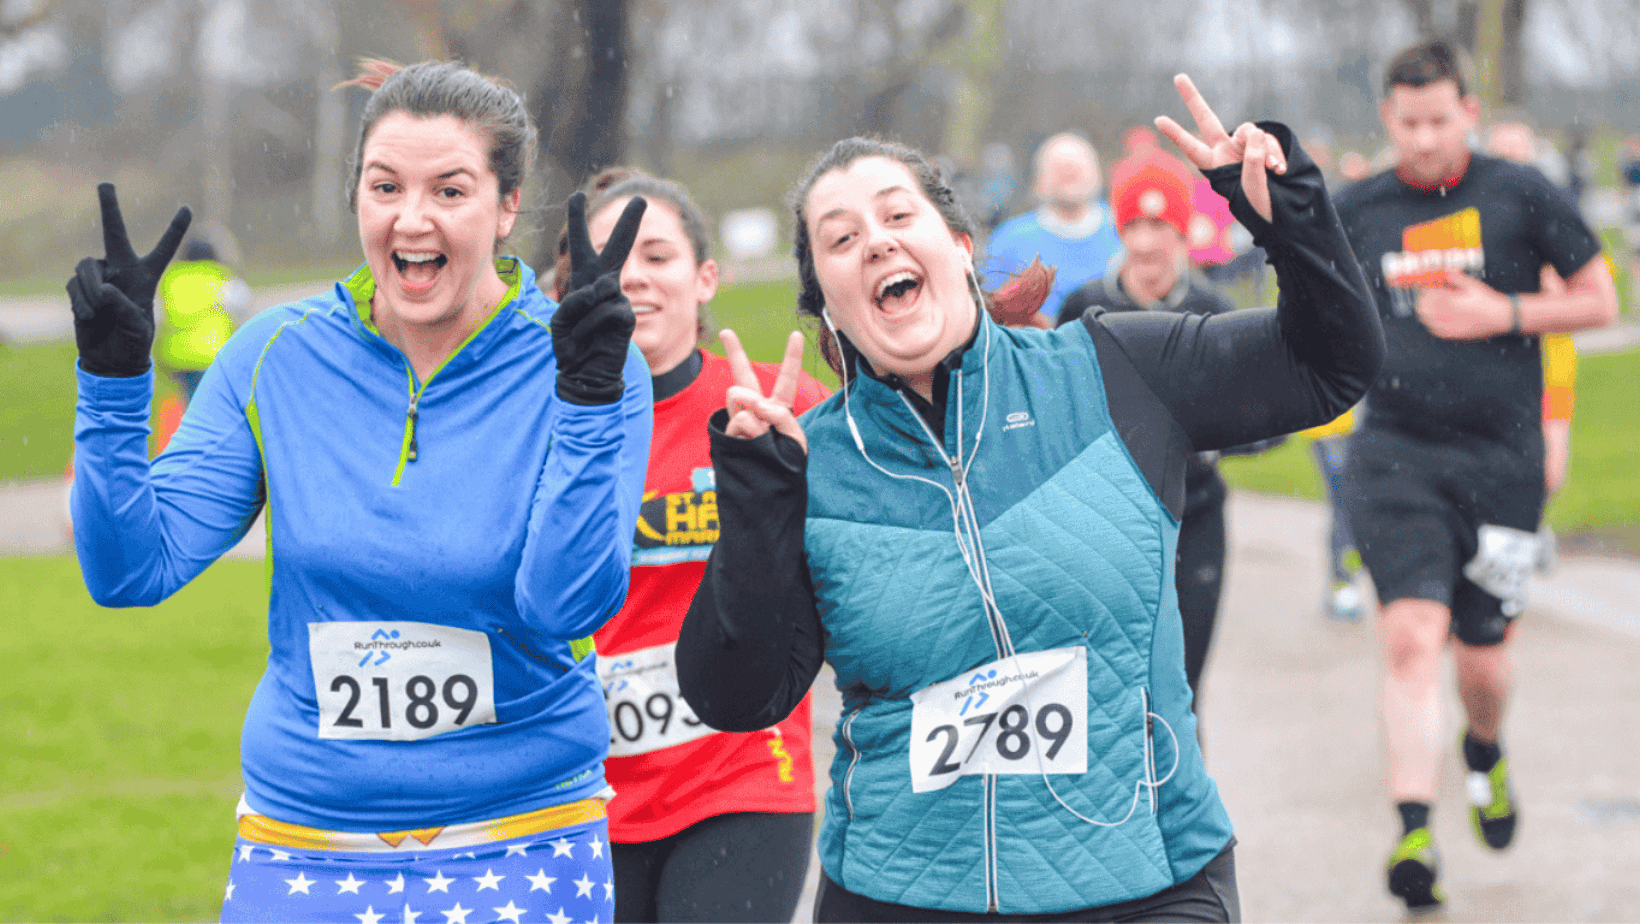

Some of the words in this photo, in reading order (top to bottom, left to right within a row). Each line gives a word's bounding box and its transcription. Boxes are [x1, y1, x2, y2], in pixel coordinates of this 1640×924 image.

[354, 639, 442, 651] RunThrough.co.uk
[329, 673, 479, 730] 2189
[954, 670, 1039, 700] RunThrough.co.uk
[603, 689, 702, 744] 09
[925, 703, 1074, 777] 2789
